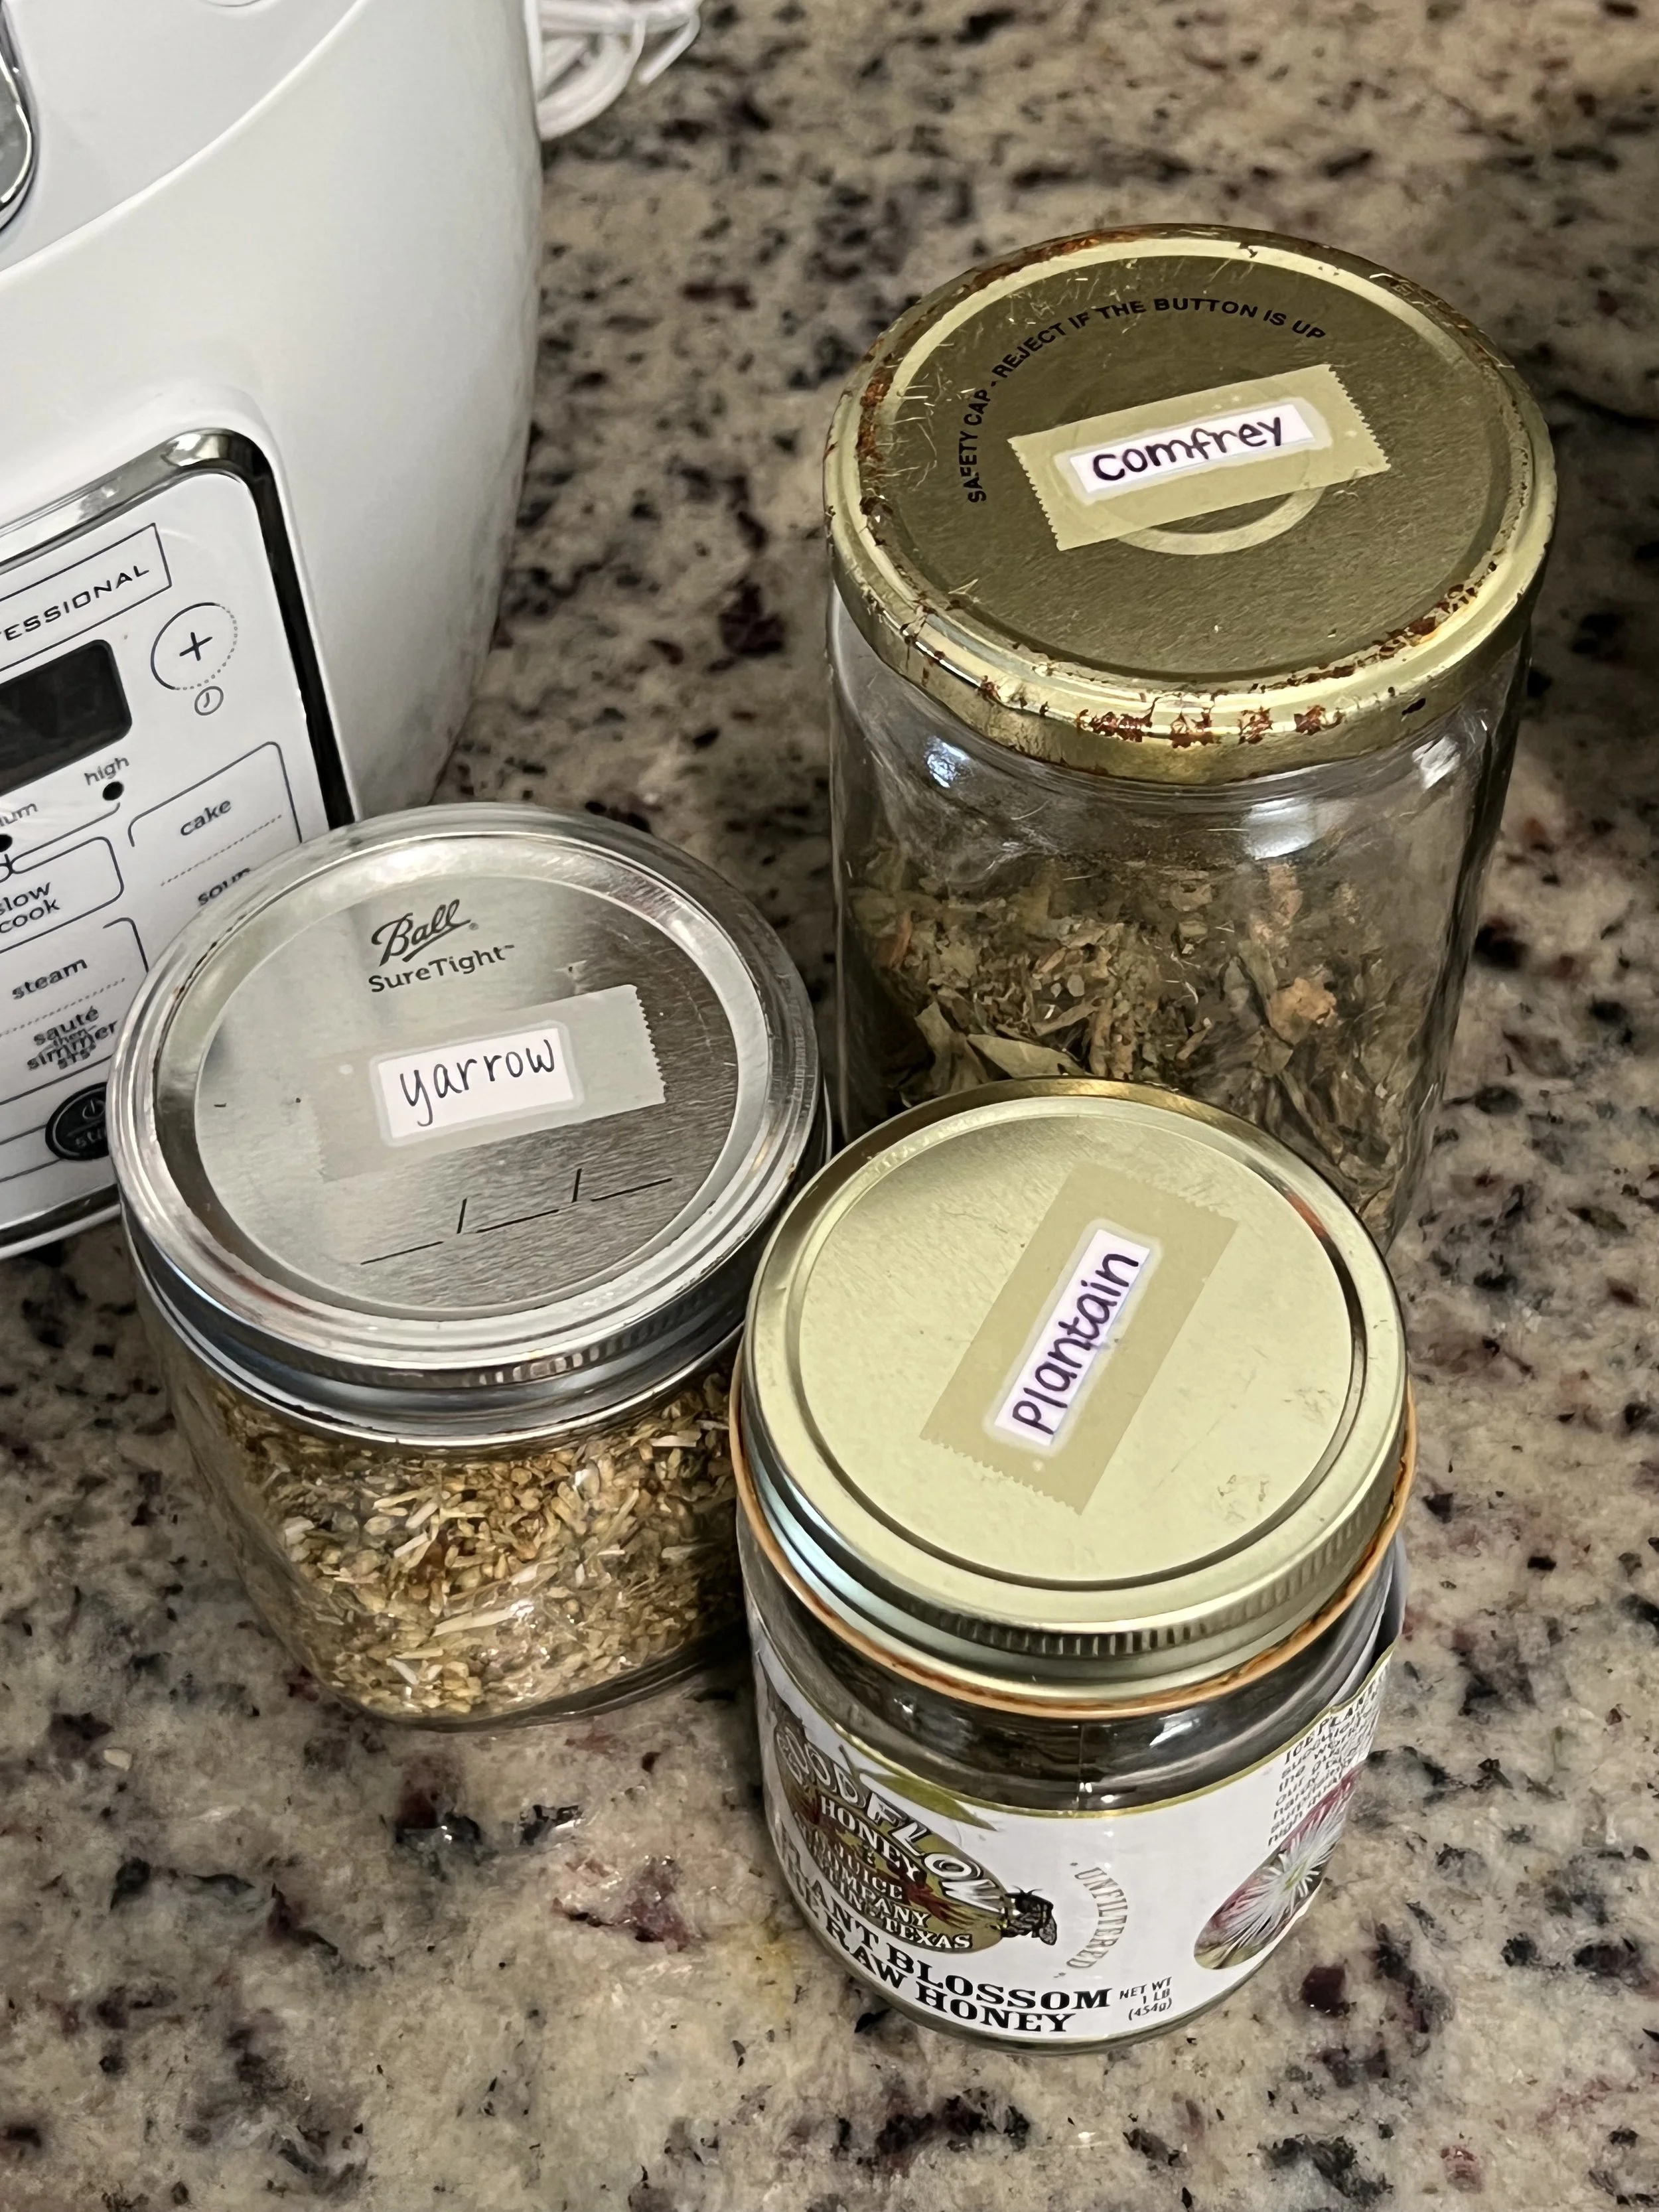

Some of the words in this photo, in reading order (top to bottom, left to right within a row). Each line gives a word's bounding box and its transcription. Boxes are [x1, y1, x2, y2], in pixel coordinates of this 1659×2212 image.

[1068, 311, 1091, 329] IF
[1094, 300, 1147, 320] THE
[1153, 297, 1258, 317] BUTTON
[1263, 309, 1287, 327] IS
[1291, 320, 1327, 339] UP
[991, 323, 1067, 378] REJECT
[964, 388, 991, 426] CAP
[959, 430, 987, 503] SAFETY
[0, 565, 149, 640] ESSIONAL
[84, 757, 129, 785] high
[180, 800, 232, 836] cake
[0, 899, 60, 933] cook
[371, 899, 472, 967] Ball
[12, 959, 88, 999] steam
[399, 1039, 555, 1126] yarrow
[1013, 1253, 1139, 1435] Plantain
[820, 1795, 921, 1882] HONEY
[885, 1917, 972, 1949] TEXAS
[1066, 1866, 1128, 1968] UNFILTERED
[826, 1912, 908, 1990] RAW
[915, 1981, 1076, 2033] HONEY
[887, 1942, 1113, 2010] BLOSSOM
[1119, 1984, 1147, 2000] NET
[1152, 1976, 1172, 1991] WT
[1142, 1995, 1147, 2004] 1
[1153, 1988, 1171, 2002] LB
